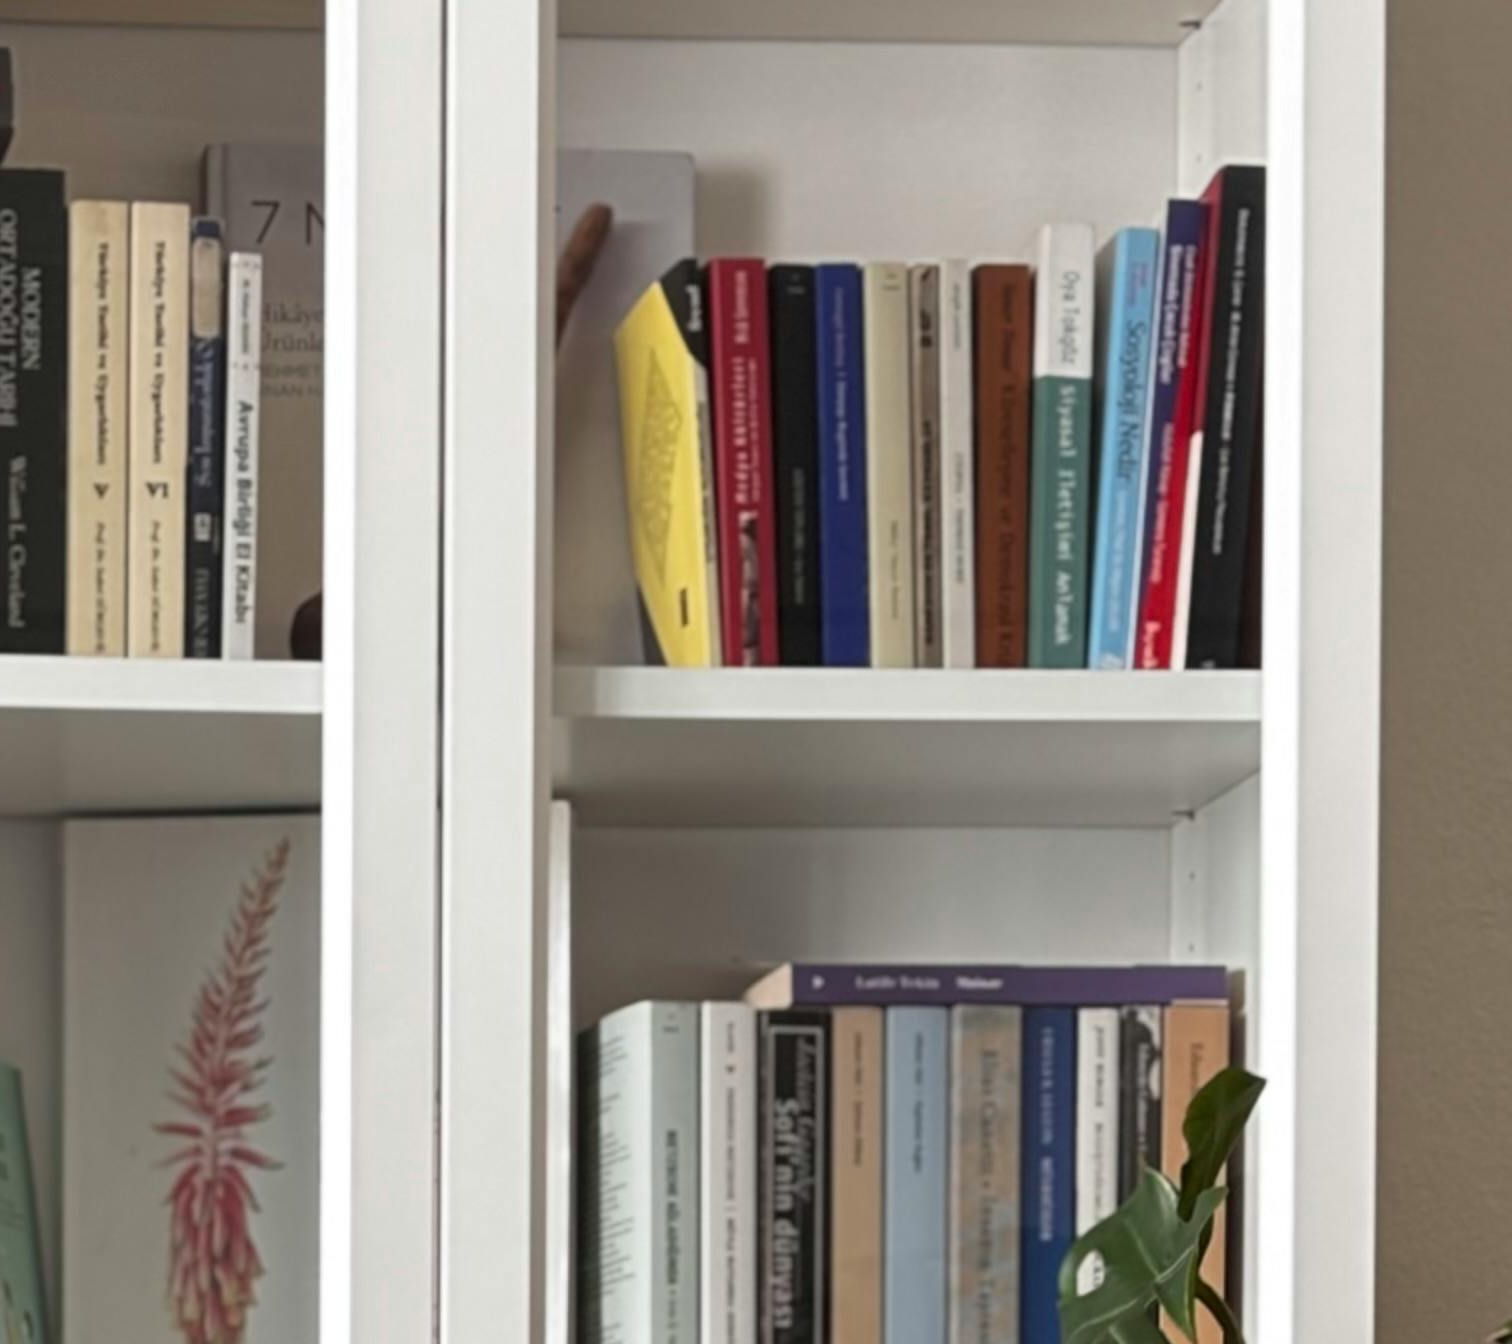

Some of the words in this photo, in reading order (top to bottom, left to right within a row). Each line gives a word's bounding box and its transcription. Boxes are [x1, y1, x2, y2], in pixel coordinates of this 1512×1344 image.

[249, 200, 280, 244] 7
[22, 267, 42, 370] MODERN
[1059, 270, 1080, 302] Oya
[1057, 309, 1080, 365] Tokgöz
[1118, 319, 1147, 415] Sosyoloji
[232, 400, 253, 473] Avrupa
[1055, 385, 1076, 458] Siyasal
[1118, 421, 1140, 481] Nedir
[232, 478, 252, 537] Birliği
[234, 565, 251, 623] Kitabı
[1055, 571, 1072, 645] Anlamak
[775, 1098, 802, 1212] Sofi'nin
[769, 1218, 800, 1328] dünyası
